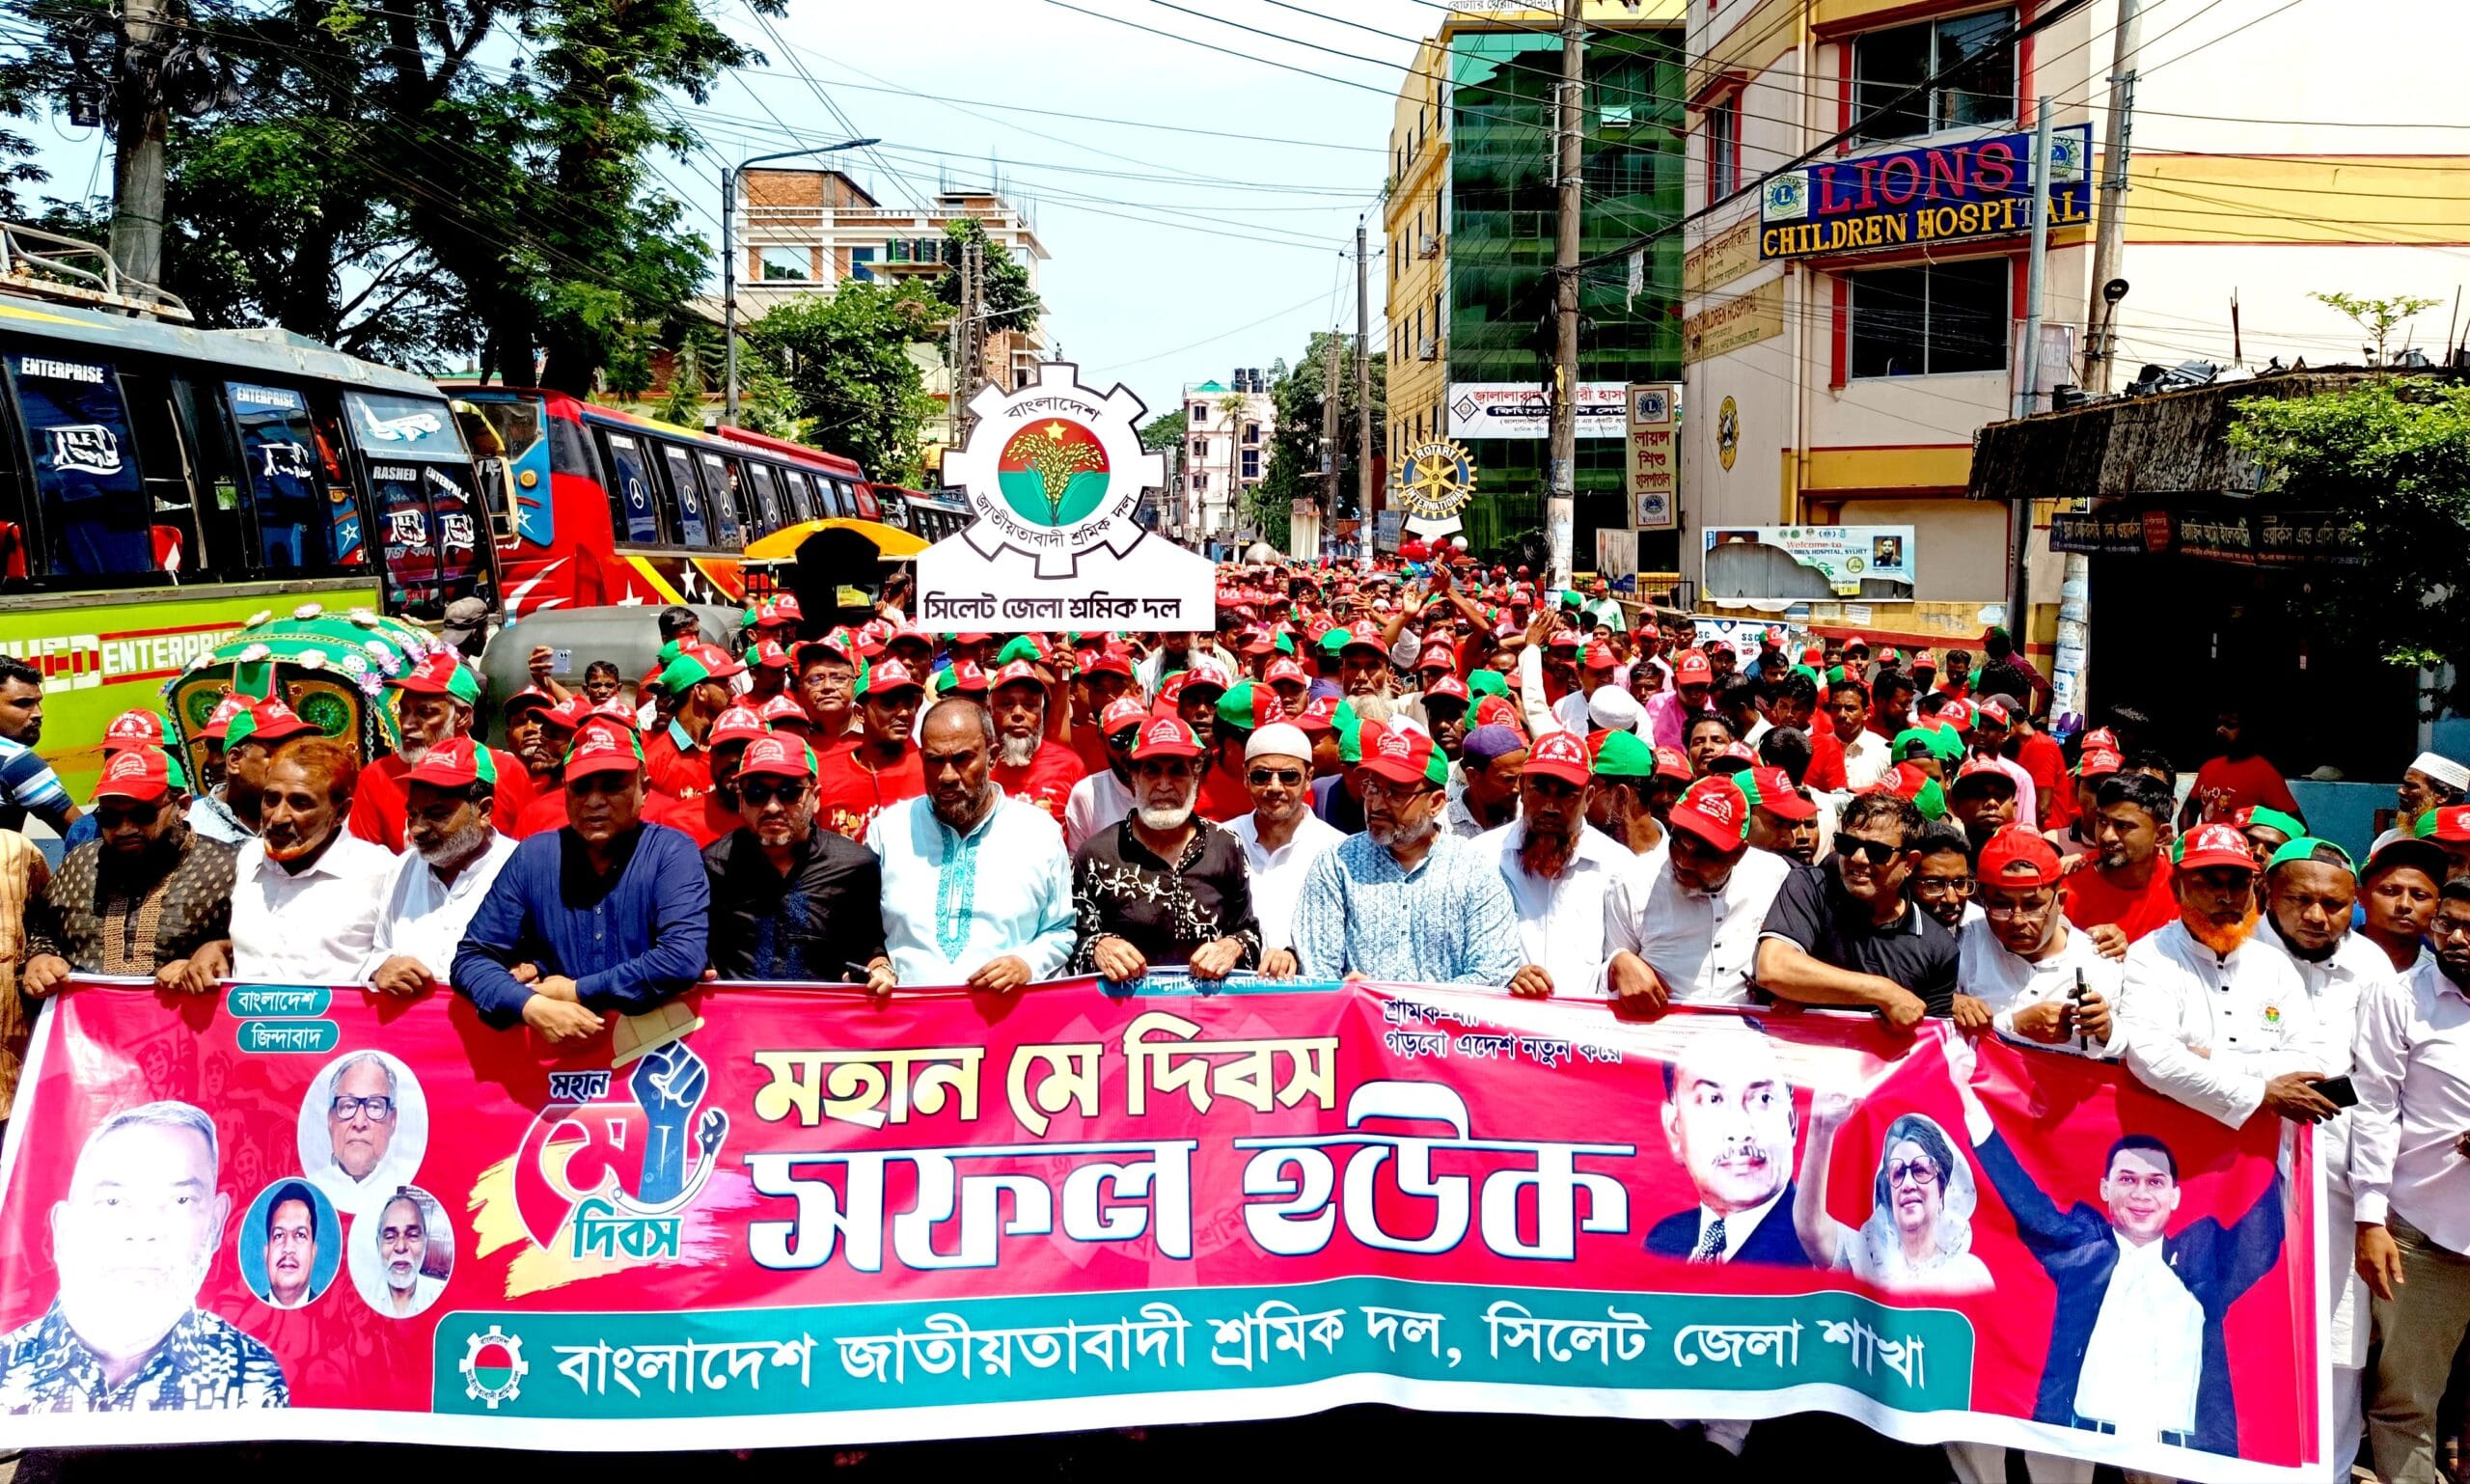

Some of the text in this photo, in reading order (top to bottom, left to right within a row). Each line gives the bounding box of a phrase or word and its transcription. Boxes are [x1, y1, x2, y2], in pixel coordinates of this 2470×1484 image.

[1818, 142, 2016, 215] LIONS
[1764, 190, 2086, 258] CHILDREN HOSPITAL
[21, 357, 104, 384] ENTERPRISE
[236, 387, 296, 408] ENTERPRISE
[1003, 396, 1104, 423] বাংলাদেশ
[1415, 444, 1457, 460] ROTARY
[372, 465, 417, 481] RASHED
[1406, 486, 1467, 511] INTERNATIONAL
[976, 492, 1137, 549] জাতীয়তাবাদী শ্রমিক দল
[923, 591, 1182, 619] সিলেট জেলা শ্রমিক দল
[237, 989, 318, 1013] বাংলাদেশ
[251, 1022, 324, 1049] জিন্দাবাদ
[1386, 1031, 1447, 1058] গড়বো
[1458, 1035, 1517, 1058] এদেশ
[1523, 1037, 1572, 1065] নতুন
[550, 1072, 610, 1102] মহান
[755, 1010, 1341, 1139] মহান মে দিবস
[744, 1077, 1636, 1272] সফল হউক
[572, 1197, 681, 1258] দিবস
[555, 1301, 1926, 1397] বাংলাদেশ জাতীয়তাবাদী শ্রমিক দল, সিলেট জেলা শাখা
